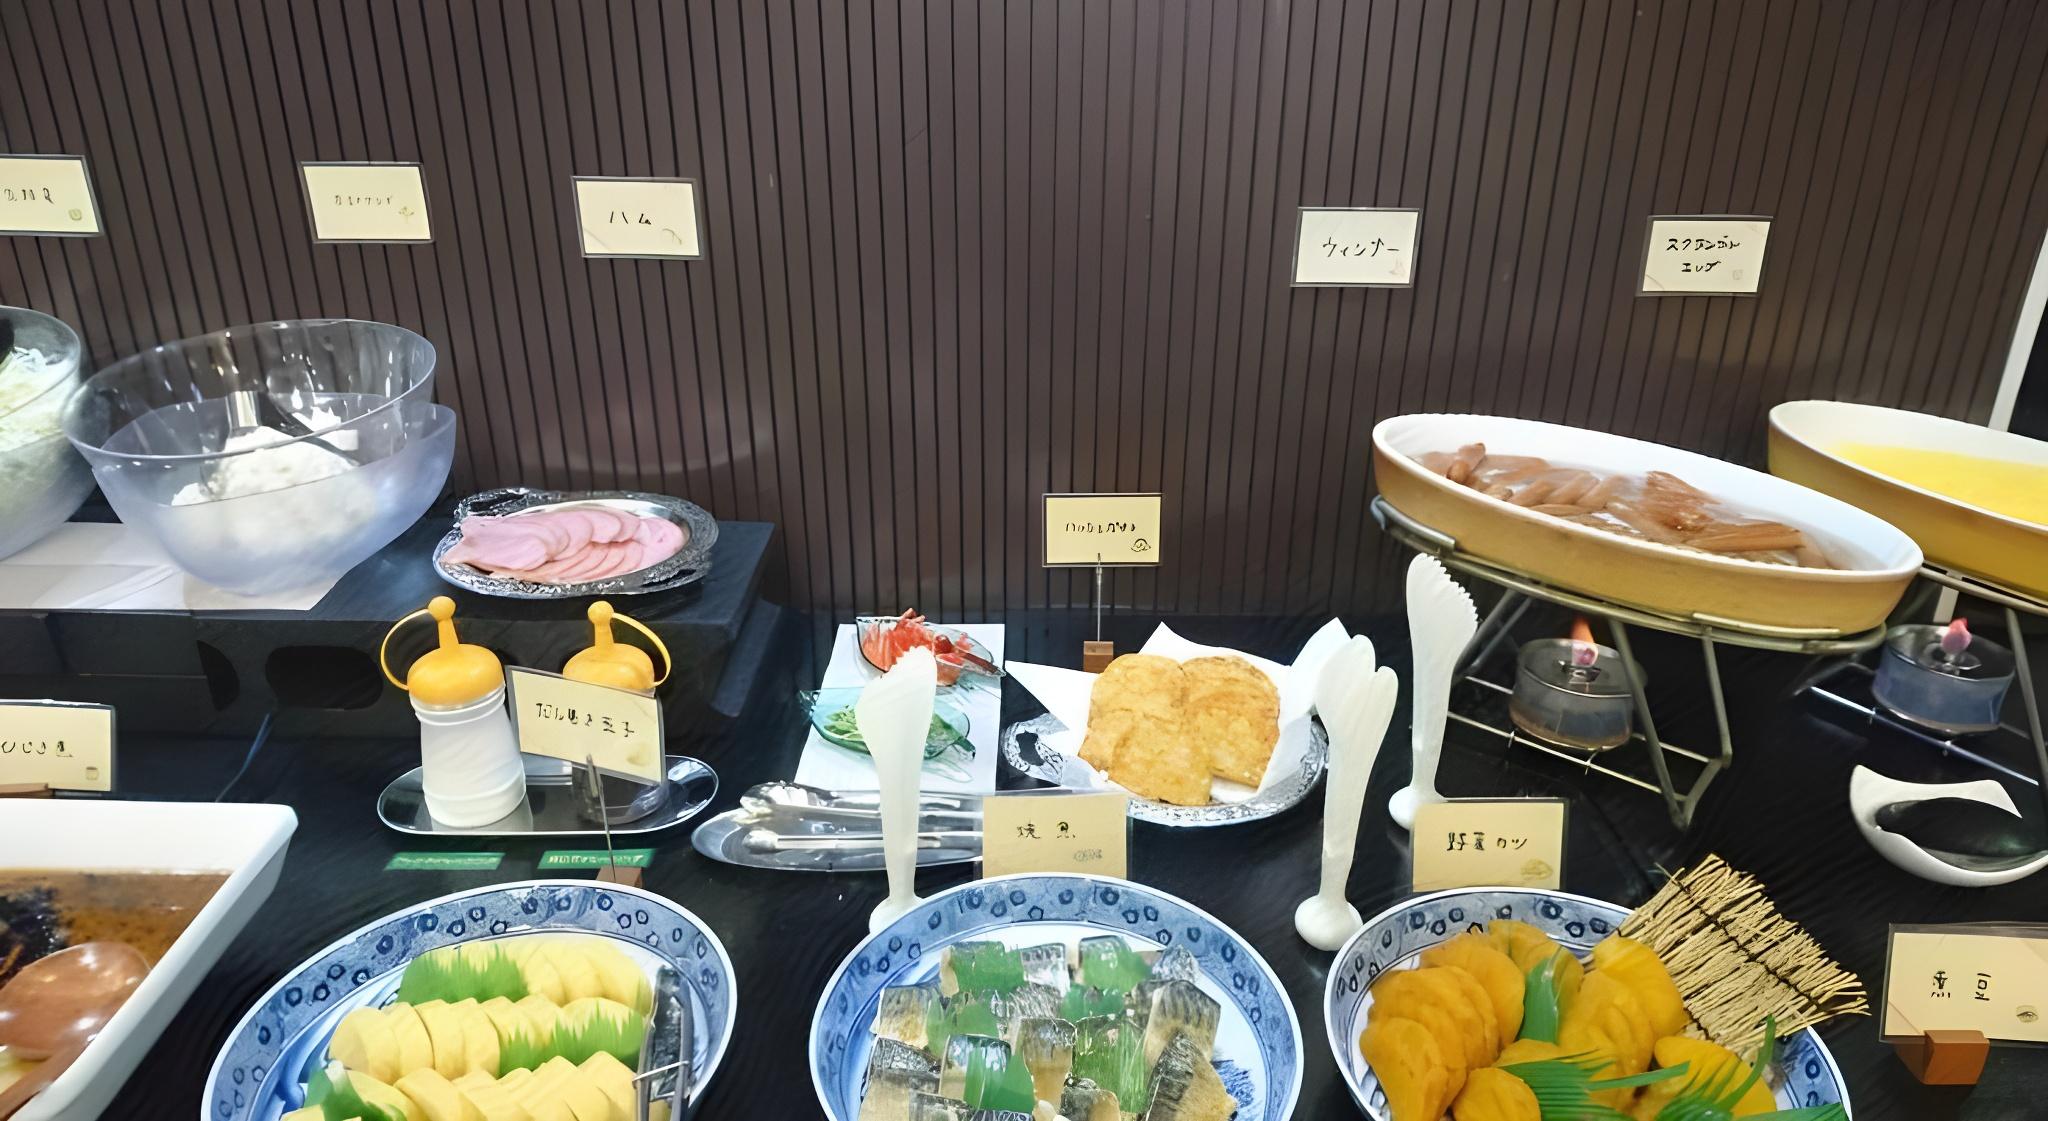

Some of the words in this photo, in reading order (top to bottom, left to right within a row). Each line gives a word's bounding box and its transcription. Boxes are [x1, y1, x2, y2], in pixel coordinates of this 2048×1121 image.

[609, 211, 652, 225] ハム
[1322, 236, 1400, 257] ウィンナー
